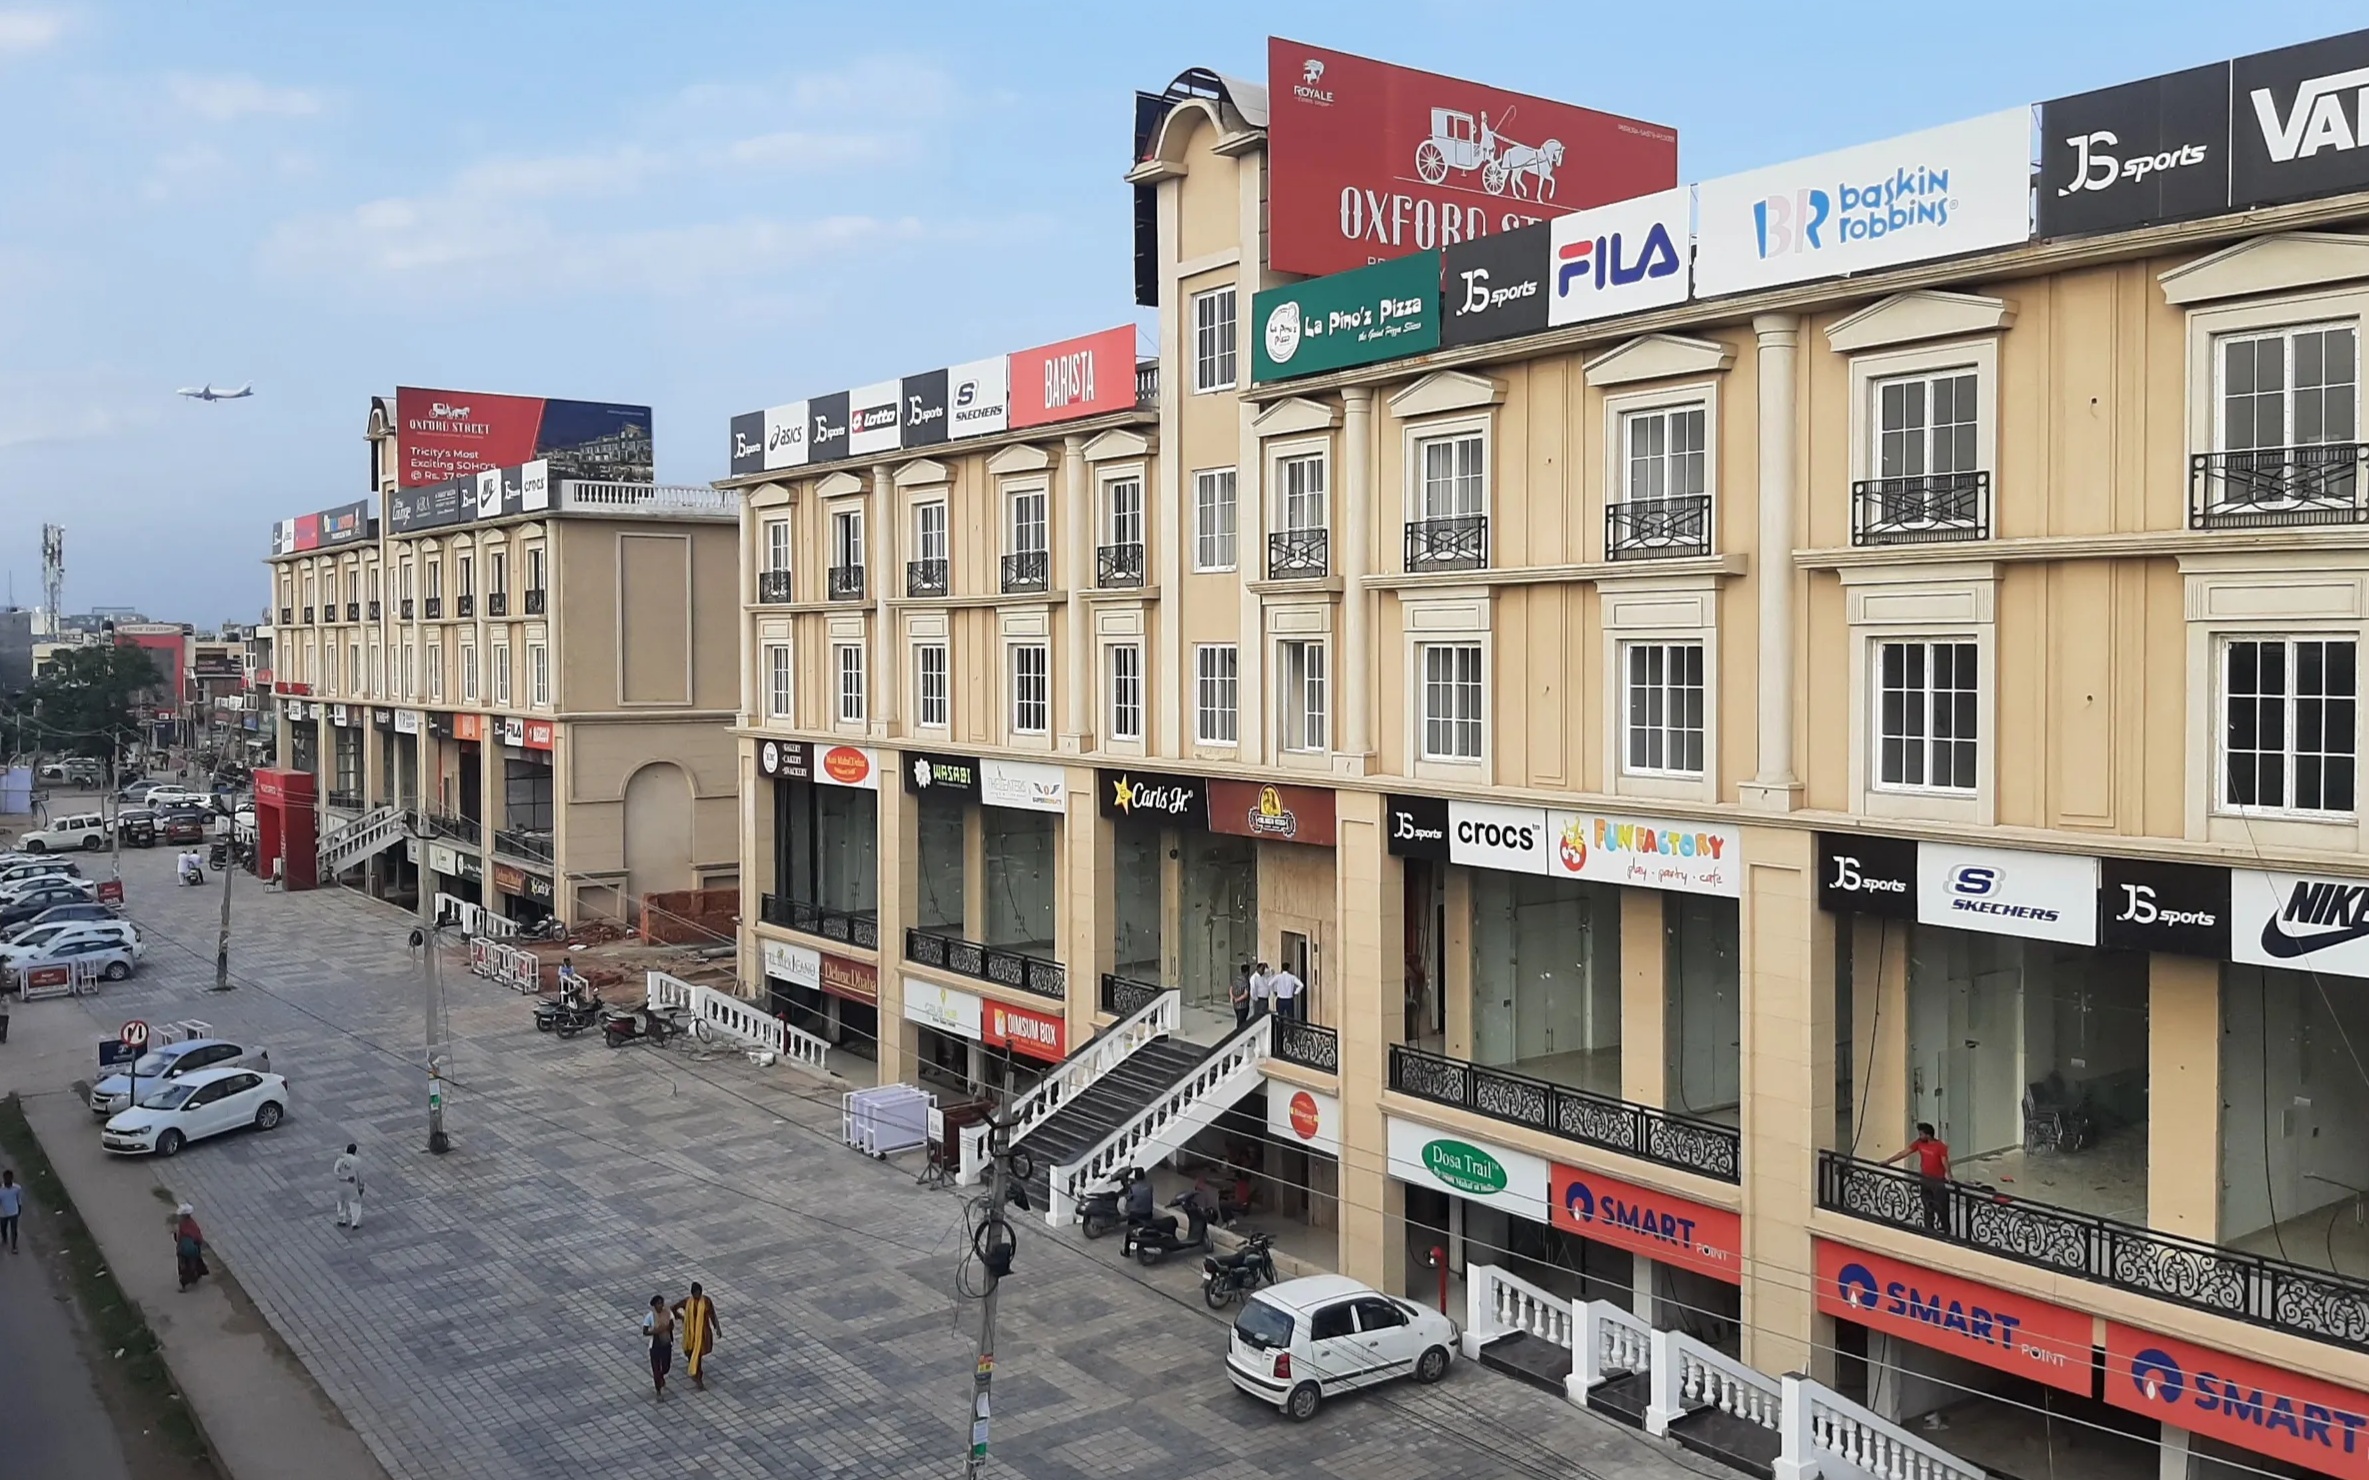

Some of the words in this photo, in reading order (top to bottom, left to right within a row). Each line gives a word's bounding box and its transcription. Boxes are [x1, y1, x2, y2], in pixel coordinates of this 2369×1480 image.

[1294, 85, 1334, 102] ROYALE
[2250, 66, 2369, 163] VA
[2121, 143, 2208, 183] sports
[1838, 165, 1949, 213] baskin
[1340, 187, 1487, 252] OXFORD
[1838, 196, 1949, 244] robbins
[1557, 222, 1680, 298] FILA
[1489, 280, 1537, 308] sports
[1304, 316, 1323, 338] La
[1329, 306, 1372, 336] Pino'z
[1380, 298, 1422, 325] Pizza
[1044, 350, 1094, 409] BARISTA
[409, 419, 449, 432] OXFORD
[452, 421, 490, 435] STREET
[922, 406, 944, 423] sports
[955, 405, 1003, 422] SKECHERS
[780, 426, 803, 446] asics
[410, 459, 454, 471] Exciting
[454, 449, 479, 459] Most
[524, 478, 544, 492] crocs
[933, 763, 971, 785] WASABI
[1131, 782, 1168, 809] Carl's
[1414, 828, 1443, 841] sports
[1457, 820, 1534, 851] crocs
[1594, 818, 1634, 852] FUN
[1635, 826, 1725, 860] FACTORY
[1861, 878, 1907, 894] sports
[1951, 898, 2060, 923] SKECHERS
[2158, 908, 2216, 928] sports
[825, 962, 850, 985] Deluxe
[851, 969, 877, 991] Dhaba
[1007, 1013, 1039, 1040] DIMSUM
[1039, 1021, 1057, 1047] BOX
[1432, 1145, 1462, 1171] Dosa
[1464, 1154, 1492, 1180] Trail
[1599, 1196, 1695, 1249] SMART
[1696, 1242, 1728, 1263] POINT
[1886, 1282, 2020, 1350] SMART
[2021, 1342, 2067, 1369] POINT
[2194, 1371, 2367, 1454] SMART
